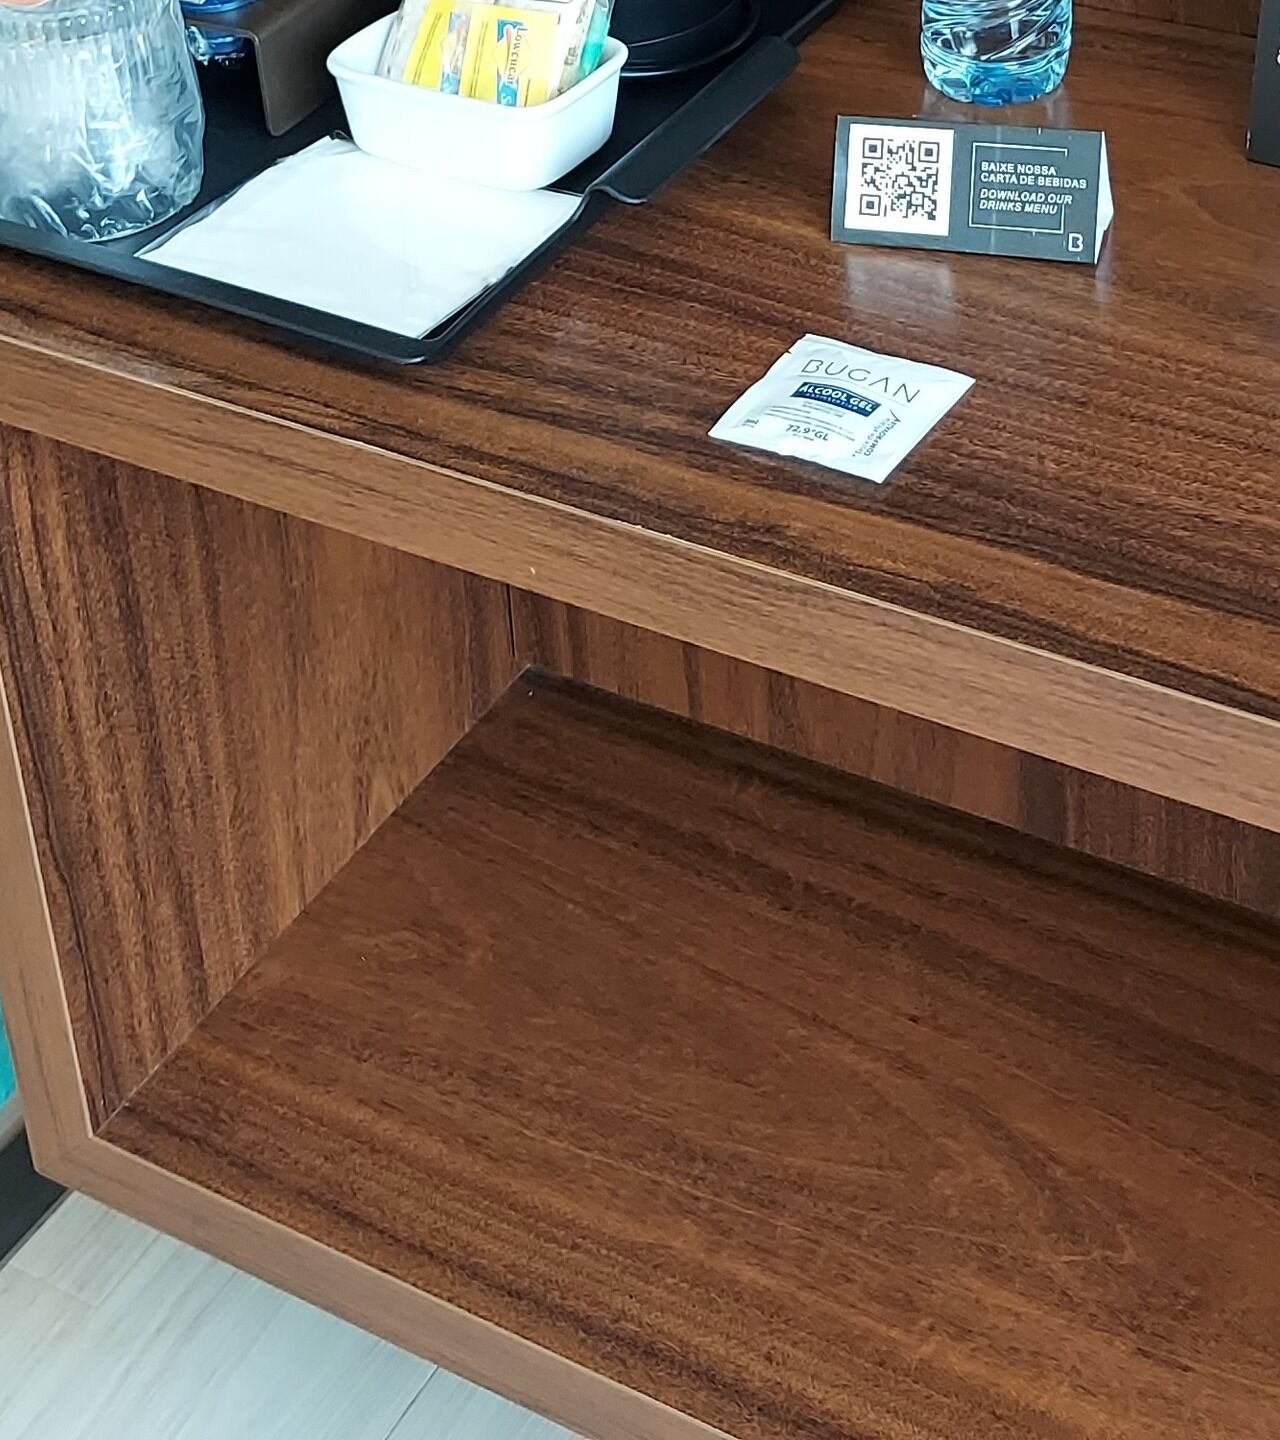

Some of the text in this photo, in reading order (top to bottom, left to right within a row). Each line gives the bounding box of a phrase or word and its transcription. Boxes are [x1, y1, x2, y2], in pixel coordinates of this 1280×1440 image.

[981, 161, 1057, 176] BAIXE NOSSA
[980, 172, 1087, 189] CARTA DE BEBIDAS
[980, 188, 1073, 205] DOWNLOAD OUR
[979, 199, 1058, 215] DRINKS MENU
[800, 358, 921, 404] BUGAN
[849, 397, 873, 412] GEL
